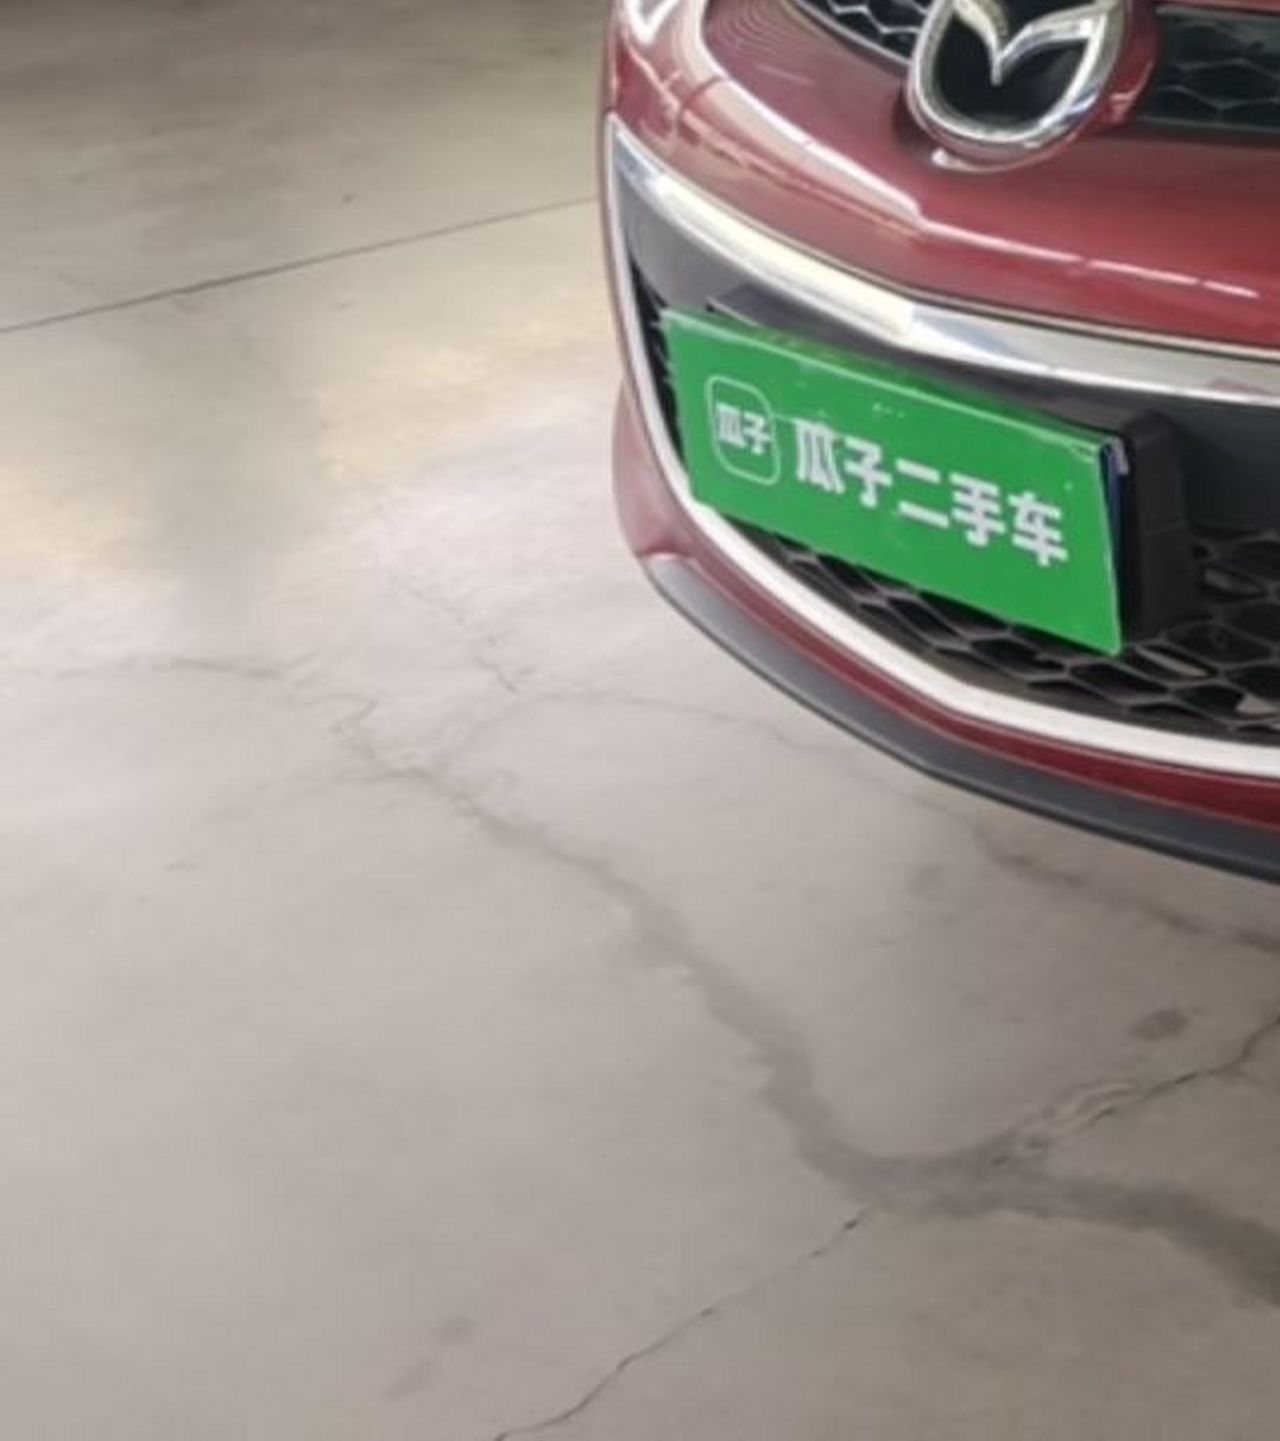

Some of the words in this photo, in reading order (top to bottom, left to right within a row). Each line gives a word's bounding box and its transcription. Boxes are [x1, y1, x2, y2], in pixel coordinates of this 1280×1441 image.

[715, 401, 772, 455] 瓜子
[794, 417, 1070, 567] 瓜子二手车
